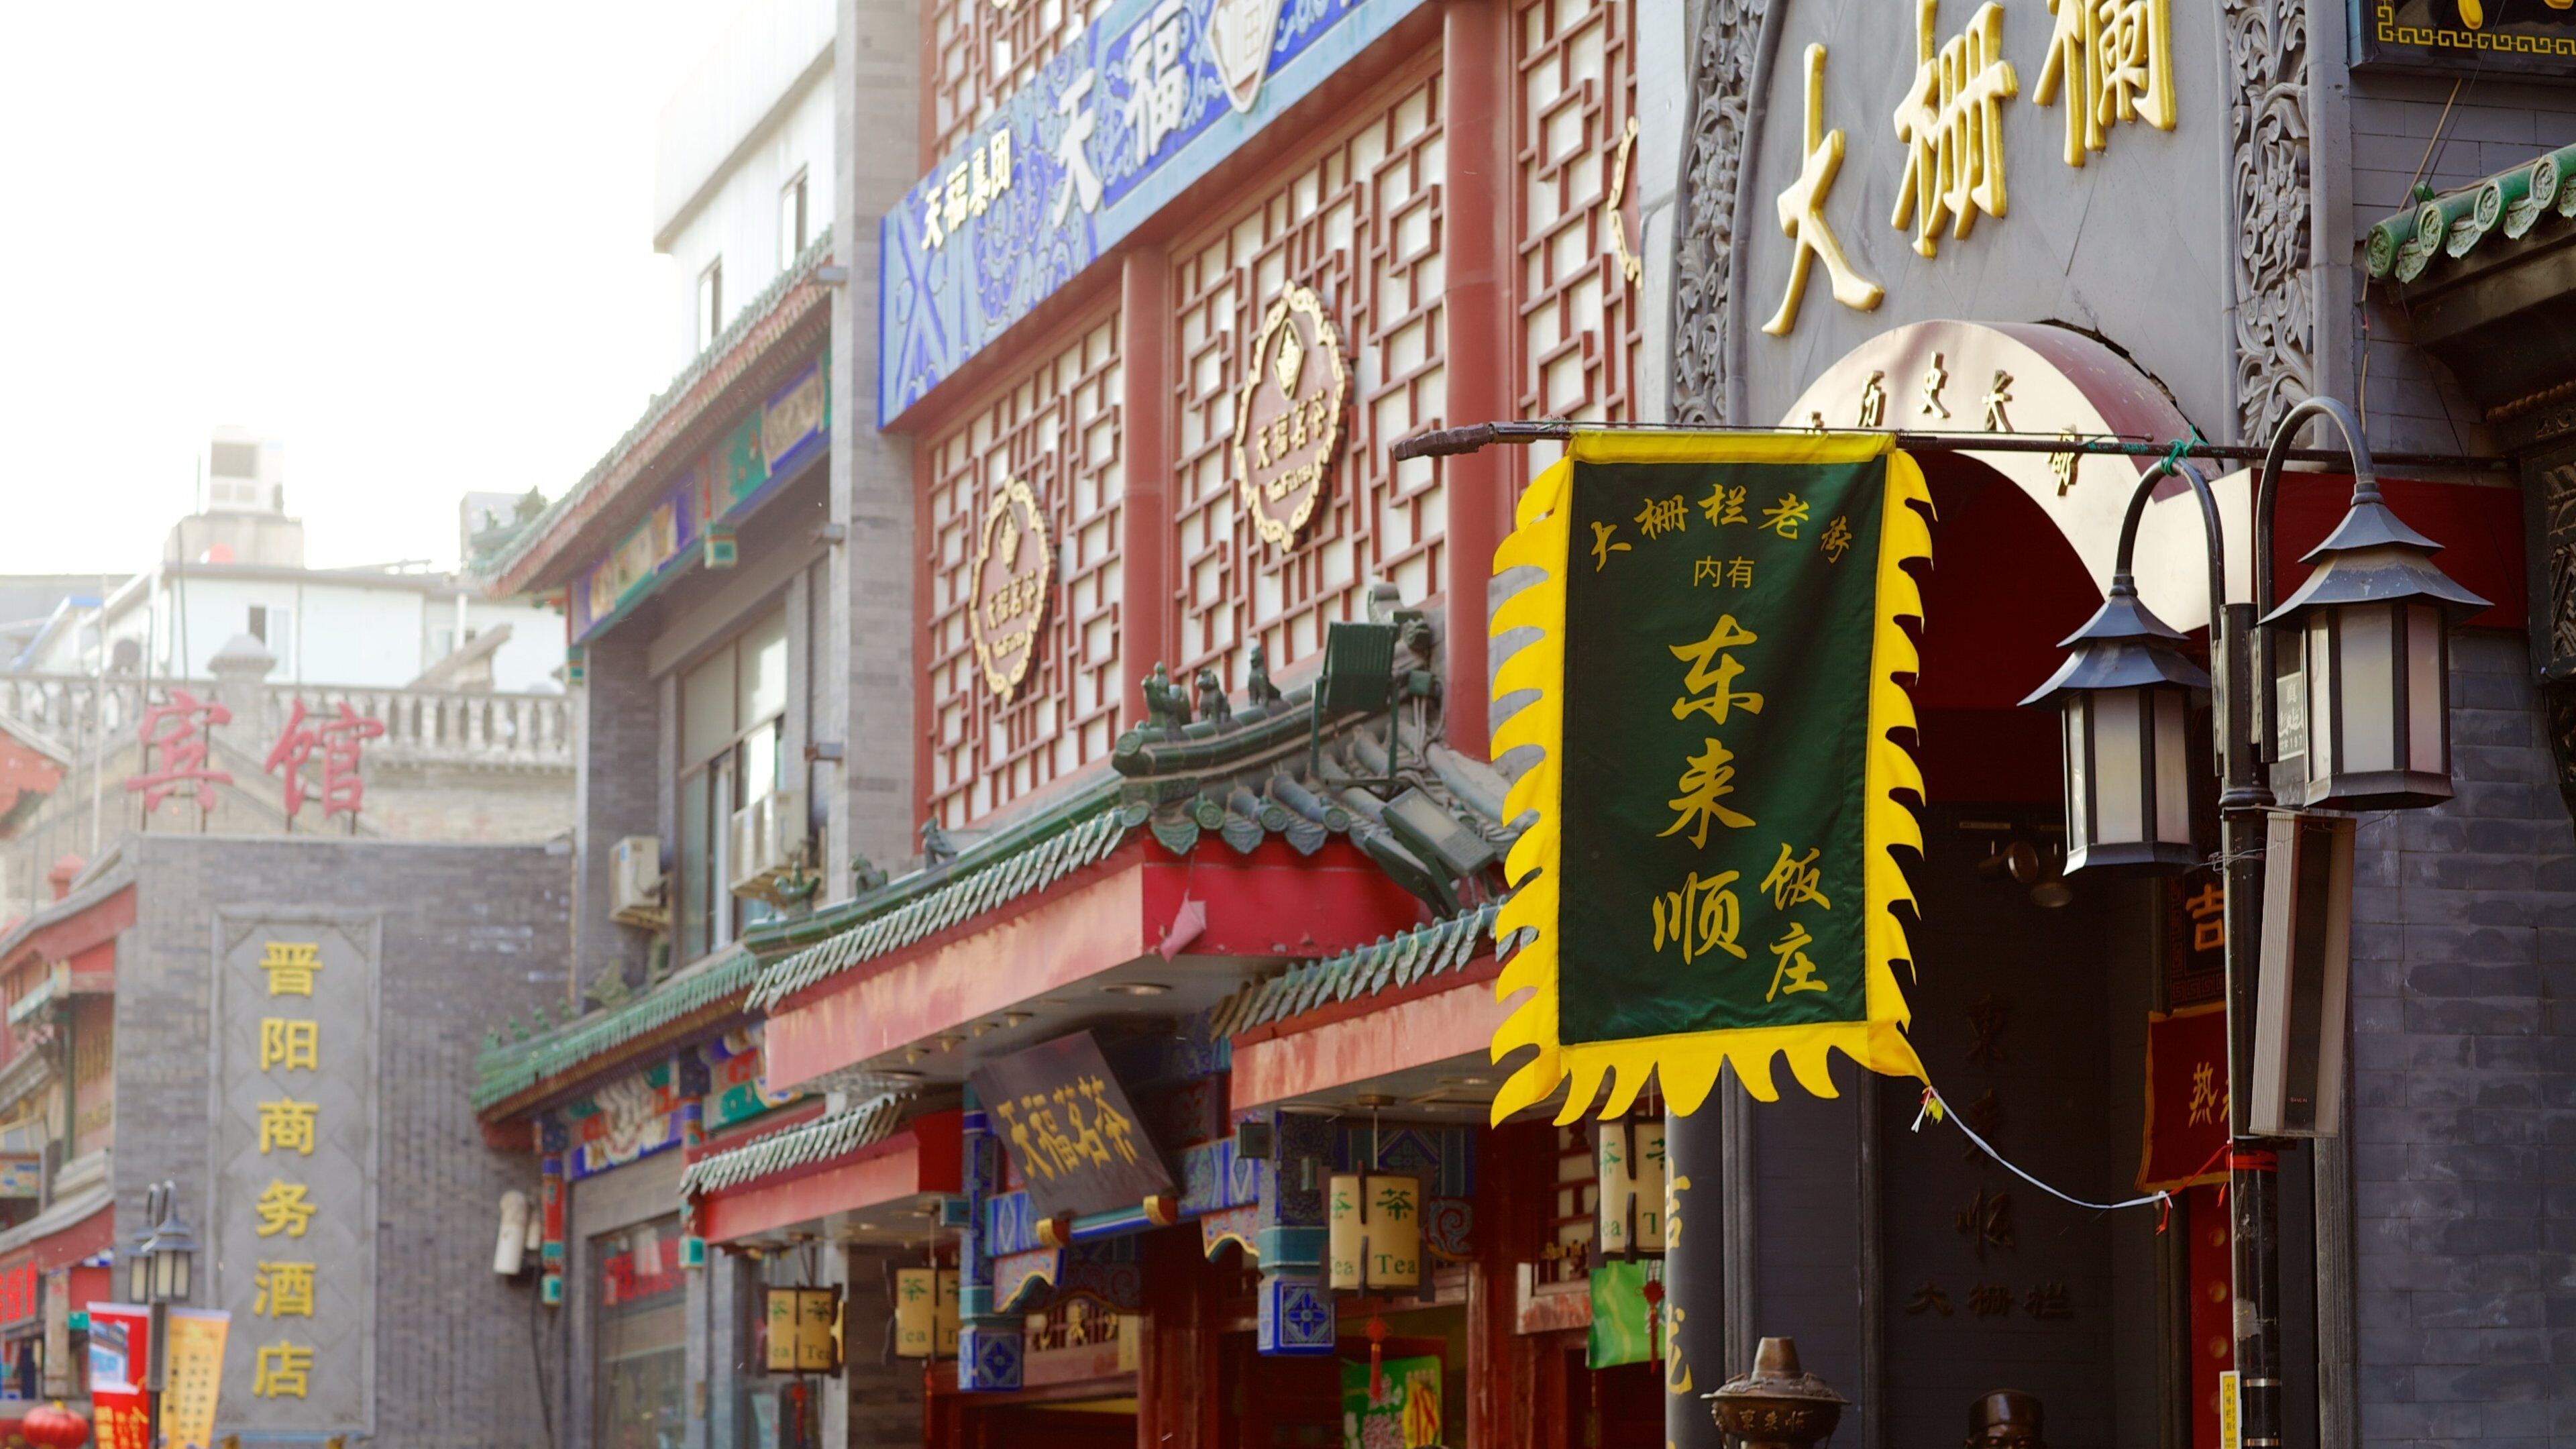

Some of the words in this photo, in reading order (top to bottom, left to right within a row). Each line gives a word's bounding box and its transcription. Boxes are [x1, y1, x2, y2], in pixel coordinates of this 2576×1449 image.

[1053, 0, 1185, 229] 天福
[921, 127, 1010, 250] 天福集团
[1254, 388, 1327, 470] 天福茗茶
[1590, 483, 1853, 573] 大栅栏老街
[1693, 555, 1755, 589] 内有
[125, 688, 386, 818] 宾馆
[1651, 613, 1764, 965] 东来顺
[1761, 842, 1831, 1002] 饭庄
[252, 941, 323, 1400] 晋阳商务酒店
[997, 1075, 1138, 1181] 天福茗茶
[1376, 1188, 1413, 1222] 茶
[902, 1277, 927, 1302] 茶
[1374, 1254, 1416, 1275] Tea
